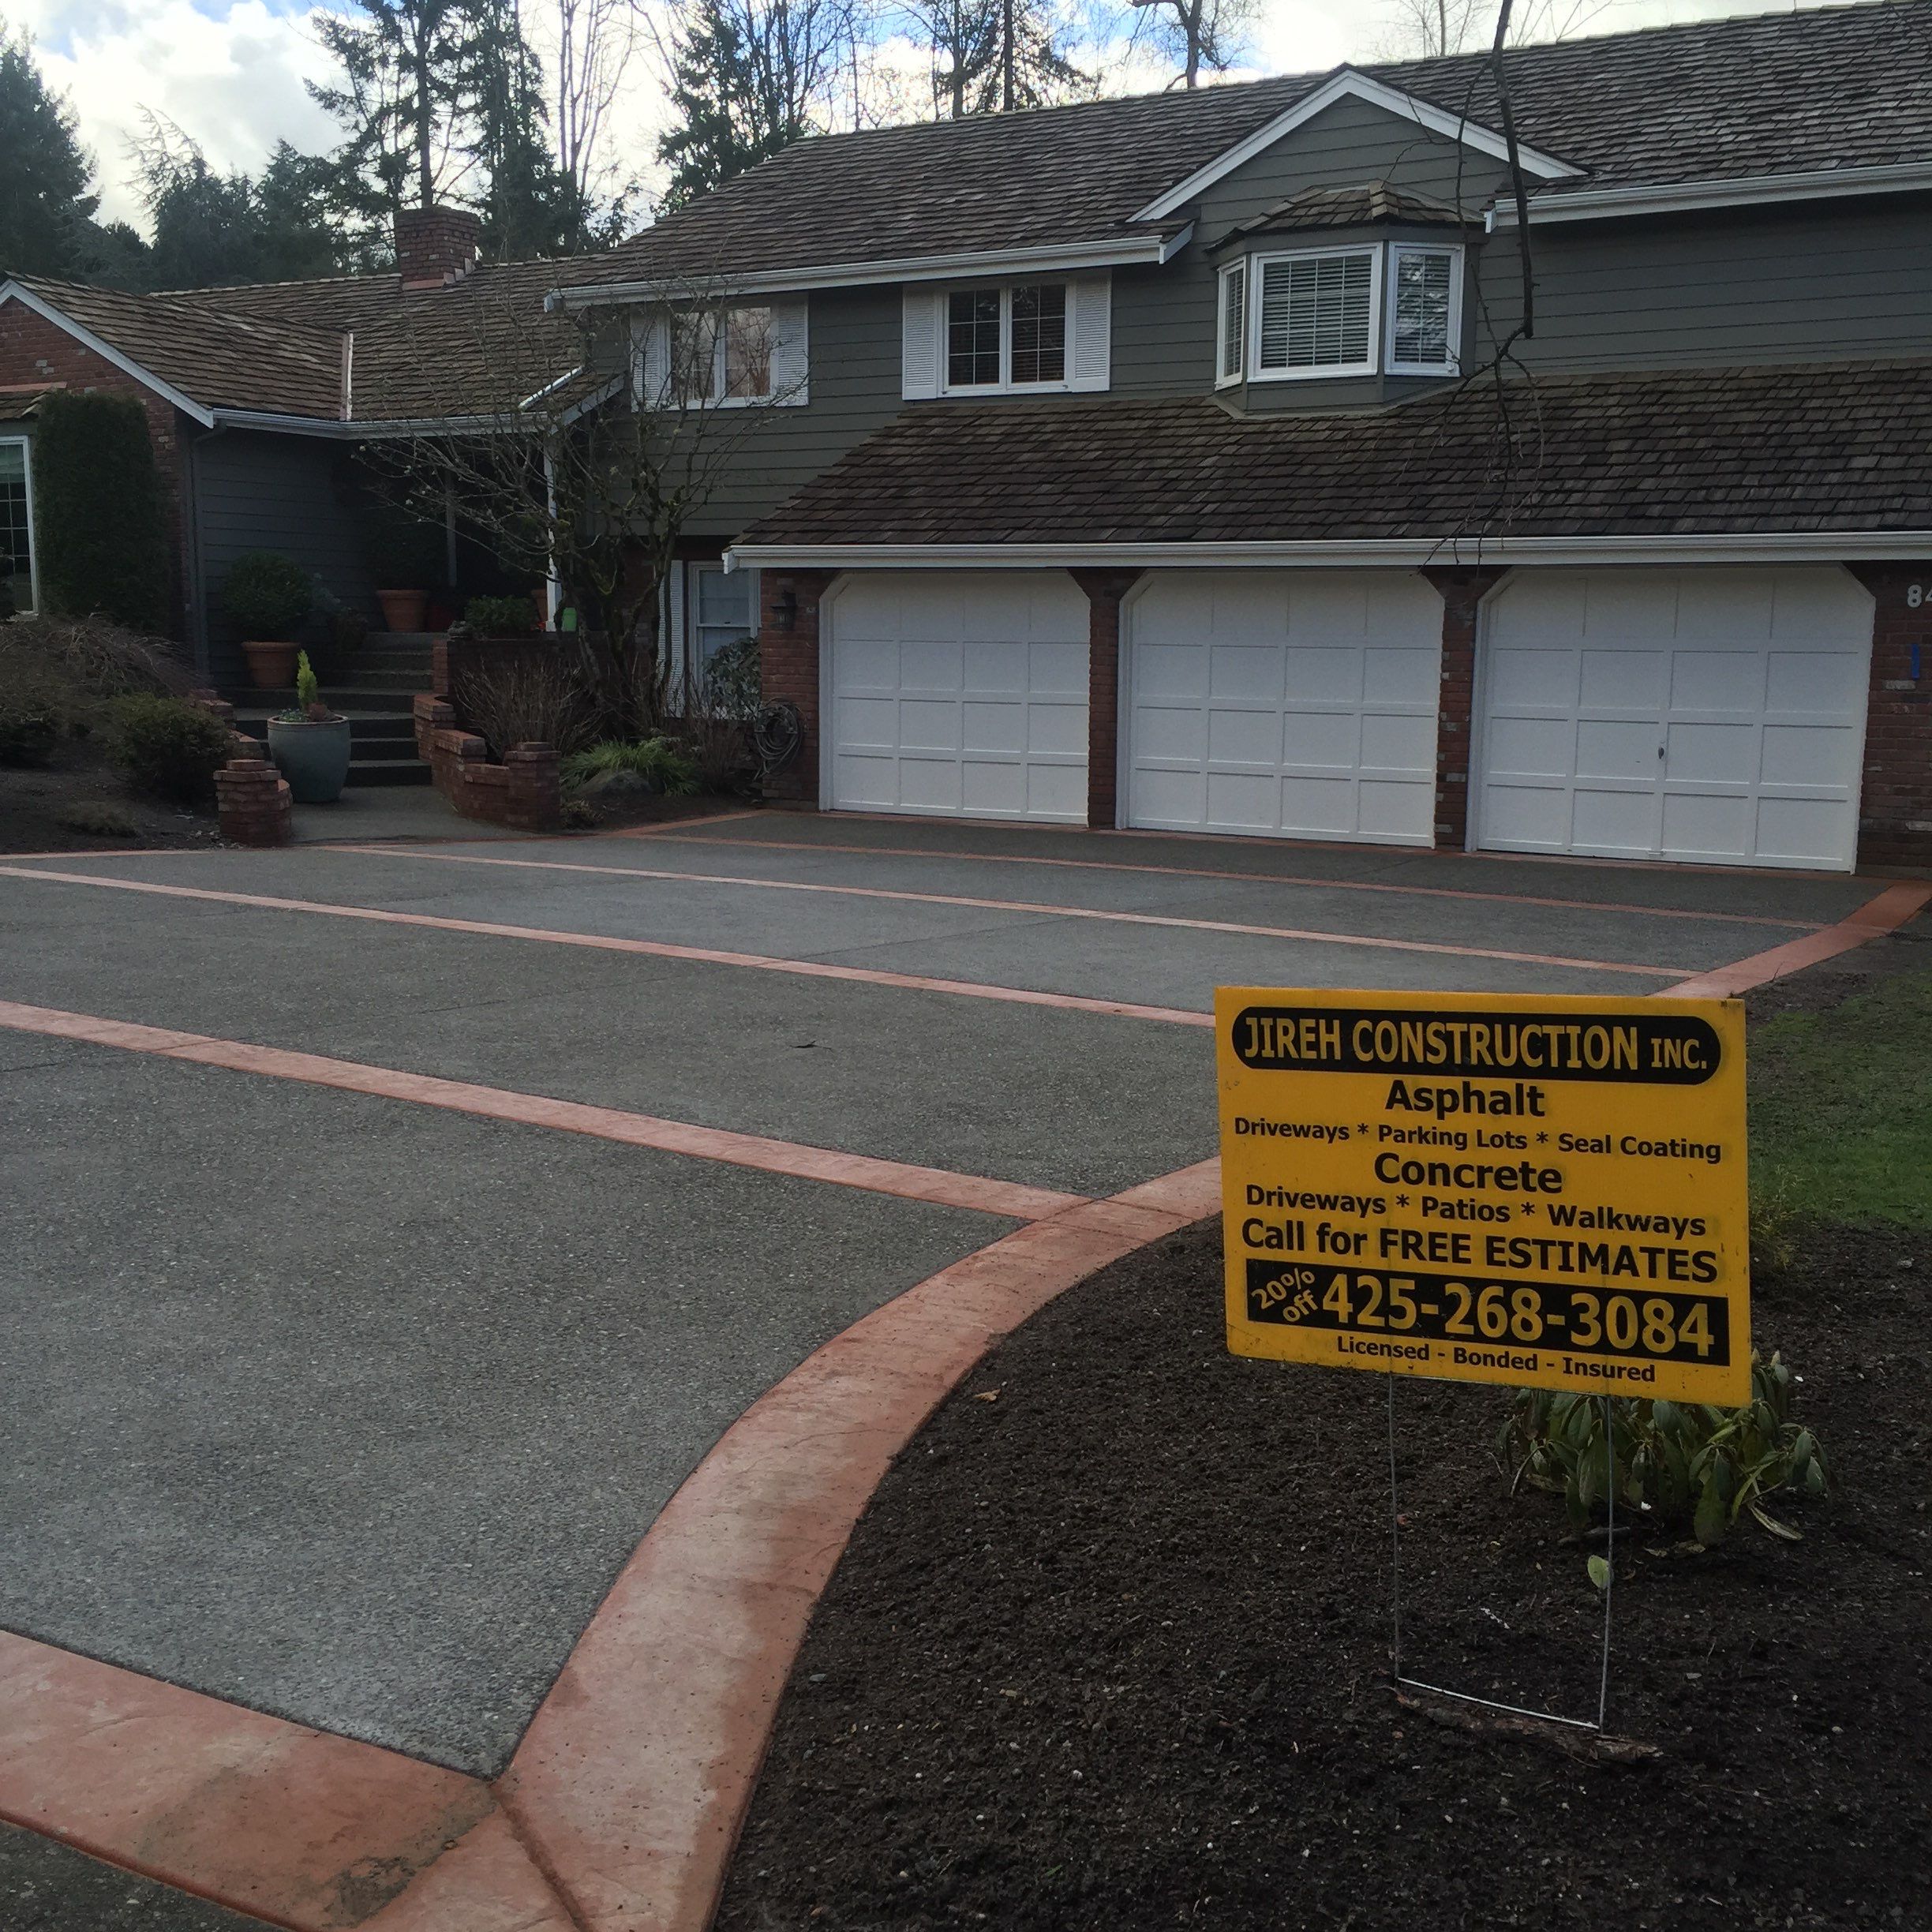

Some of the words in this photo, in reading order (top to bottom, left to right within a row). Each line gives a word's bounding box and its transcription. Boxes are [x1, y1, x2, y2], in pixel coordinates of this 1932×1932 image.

[1245, 1017, 1341, 1060] JIREH
[1352, 1019, 1639, 1070] CONSTRUCTION
[1650, 1038, 1707, 1069] INC.
[1385, 1080, 1545, 1121] Asphalt
[1234, 1118, 1350, 1142] Driveways
[1378, 1125, 1467, 1151] Parking
[1477, 1129, 1528, 1150] Lots
[1559, 1133, 1611, 1154] Seal
[1619, 1136, 1721, 1163] Coating
[1374, 1153, 1563, 1193] Concrete
[1246, 1185, 1387, 1218] Driveways
[1421, 1196, 1511, 1222] Patios
[1547, 1204, 1706, 1240] Walkways
[1241, 1218, 1305, 1252] Call
[1316, 1222, 1368, 1256] for
[1380, 1228, 1472, 1264] FREE
[1486, 1236, 1718, 1282] ESTIMATES
[1251, 1267, 1316, 1311] 20%
[1282, 1290, 1319, 1324] off
[1322, 1273, 1715, 1357] 425-268-3084
[1338, 1336, 1430, 1361] Licensed
[1454, 1347, 1538, 1372] Bonded
[1562, 1357, 1656, 1382] Insured
